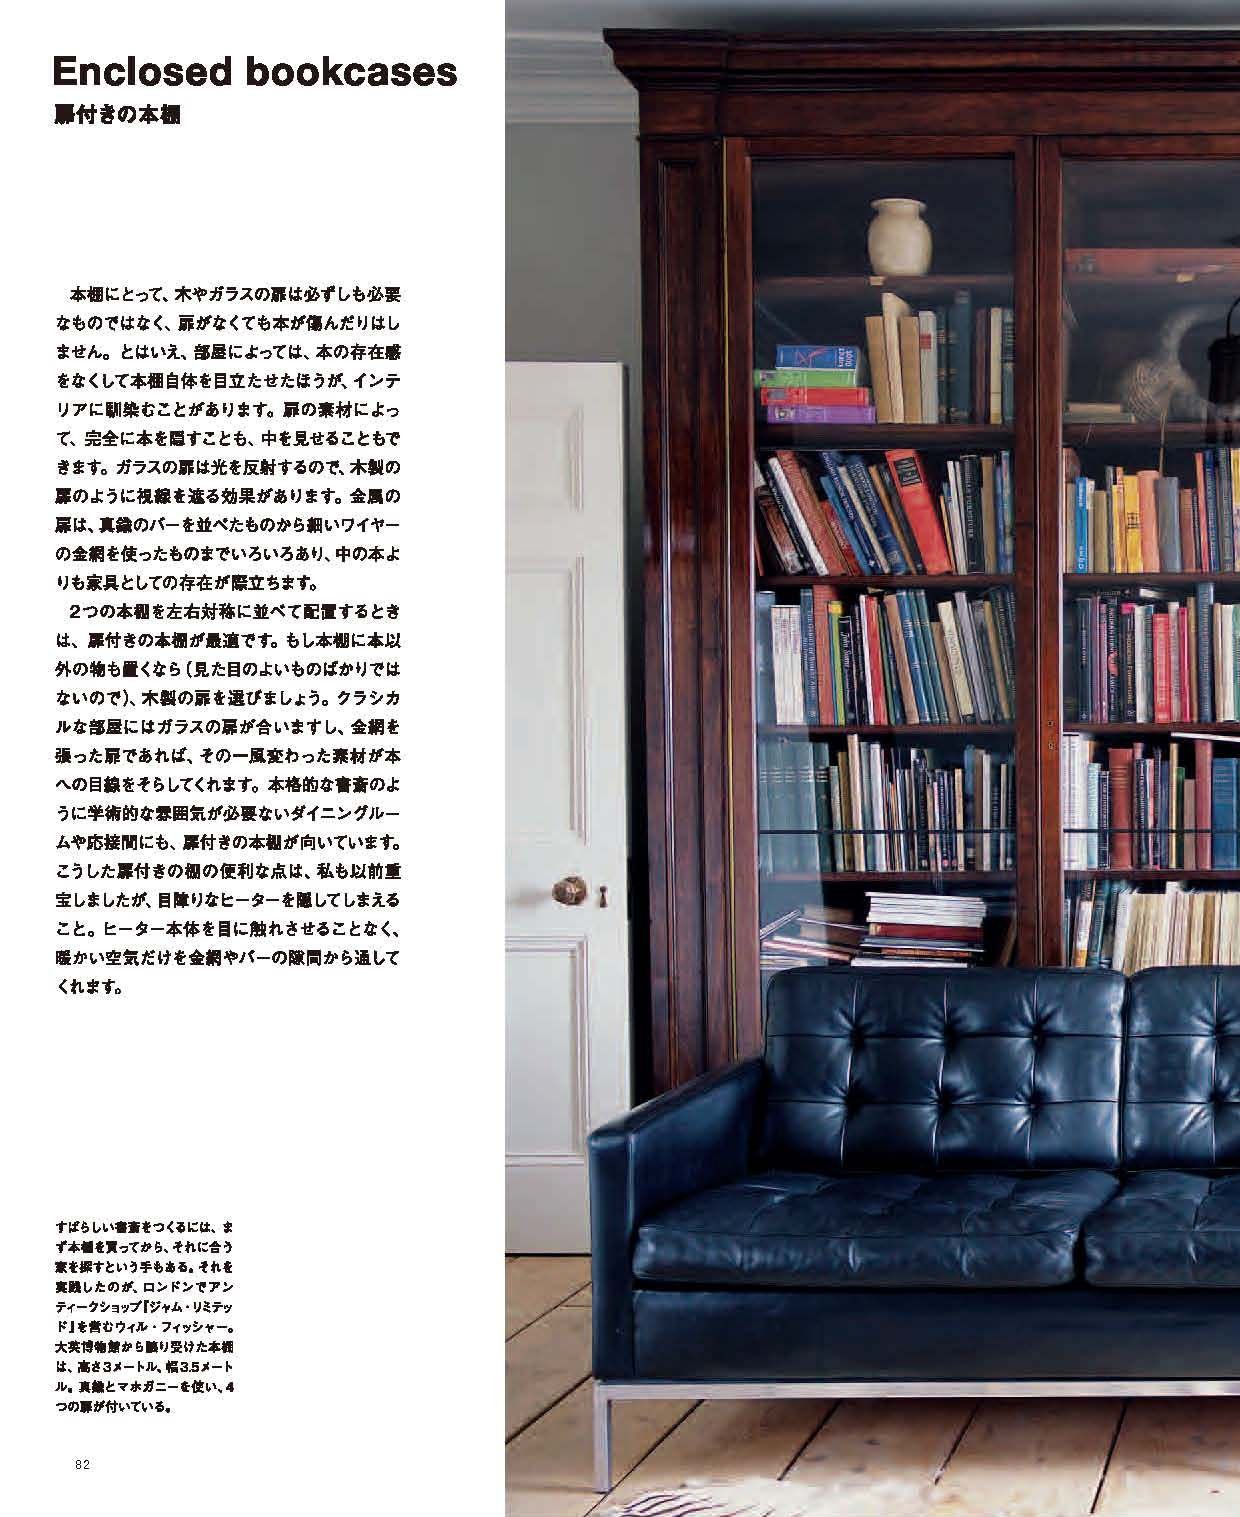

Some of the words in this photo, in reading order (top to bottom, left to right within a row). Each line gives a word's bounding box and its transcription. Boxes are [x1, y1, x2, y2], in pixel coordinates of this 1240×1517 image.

[53, 55, 232, 87] Enclosed
[246, 55, 458, 87] bookcases
[53, 103, 181, 126] 扉付きの本棚
[75, 1459, 90, 1470] 82
